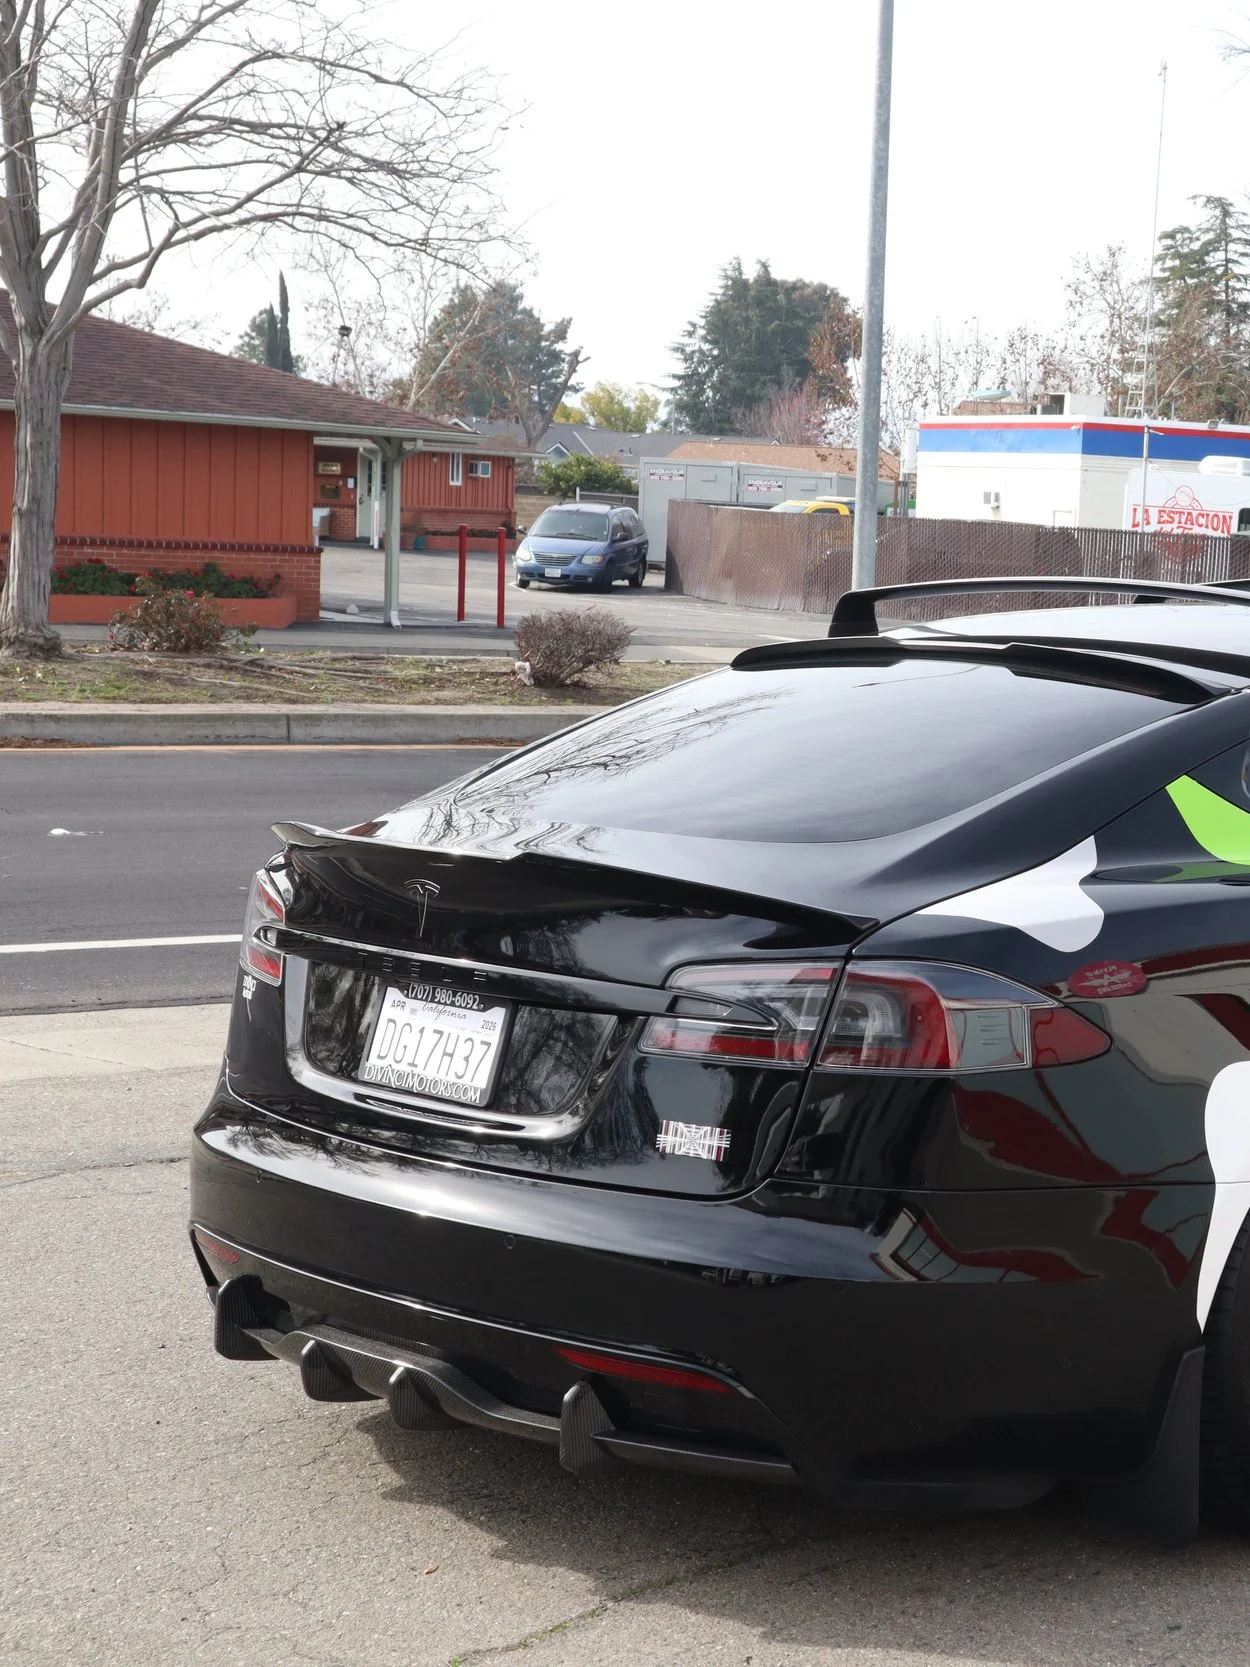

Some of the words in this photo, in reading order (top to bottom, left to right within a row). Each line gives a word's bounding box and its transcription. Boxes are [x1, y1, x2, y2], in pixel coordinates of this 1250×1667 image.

[1131, 507, 1151, 528] LA
[1157, 509, 1233, 536] ESTACION
[391, 999, 406, 1012] APR
[408, 983, 433, 1001] (707)
[434, 988, 480, 1010] 980-6092
[422, 1002, 467, 1020] California
[481, 1019, 497, 1032] 2026
[377, 1018, 492, 1083] DG17H37
